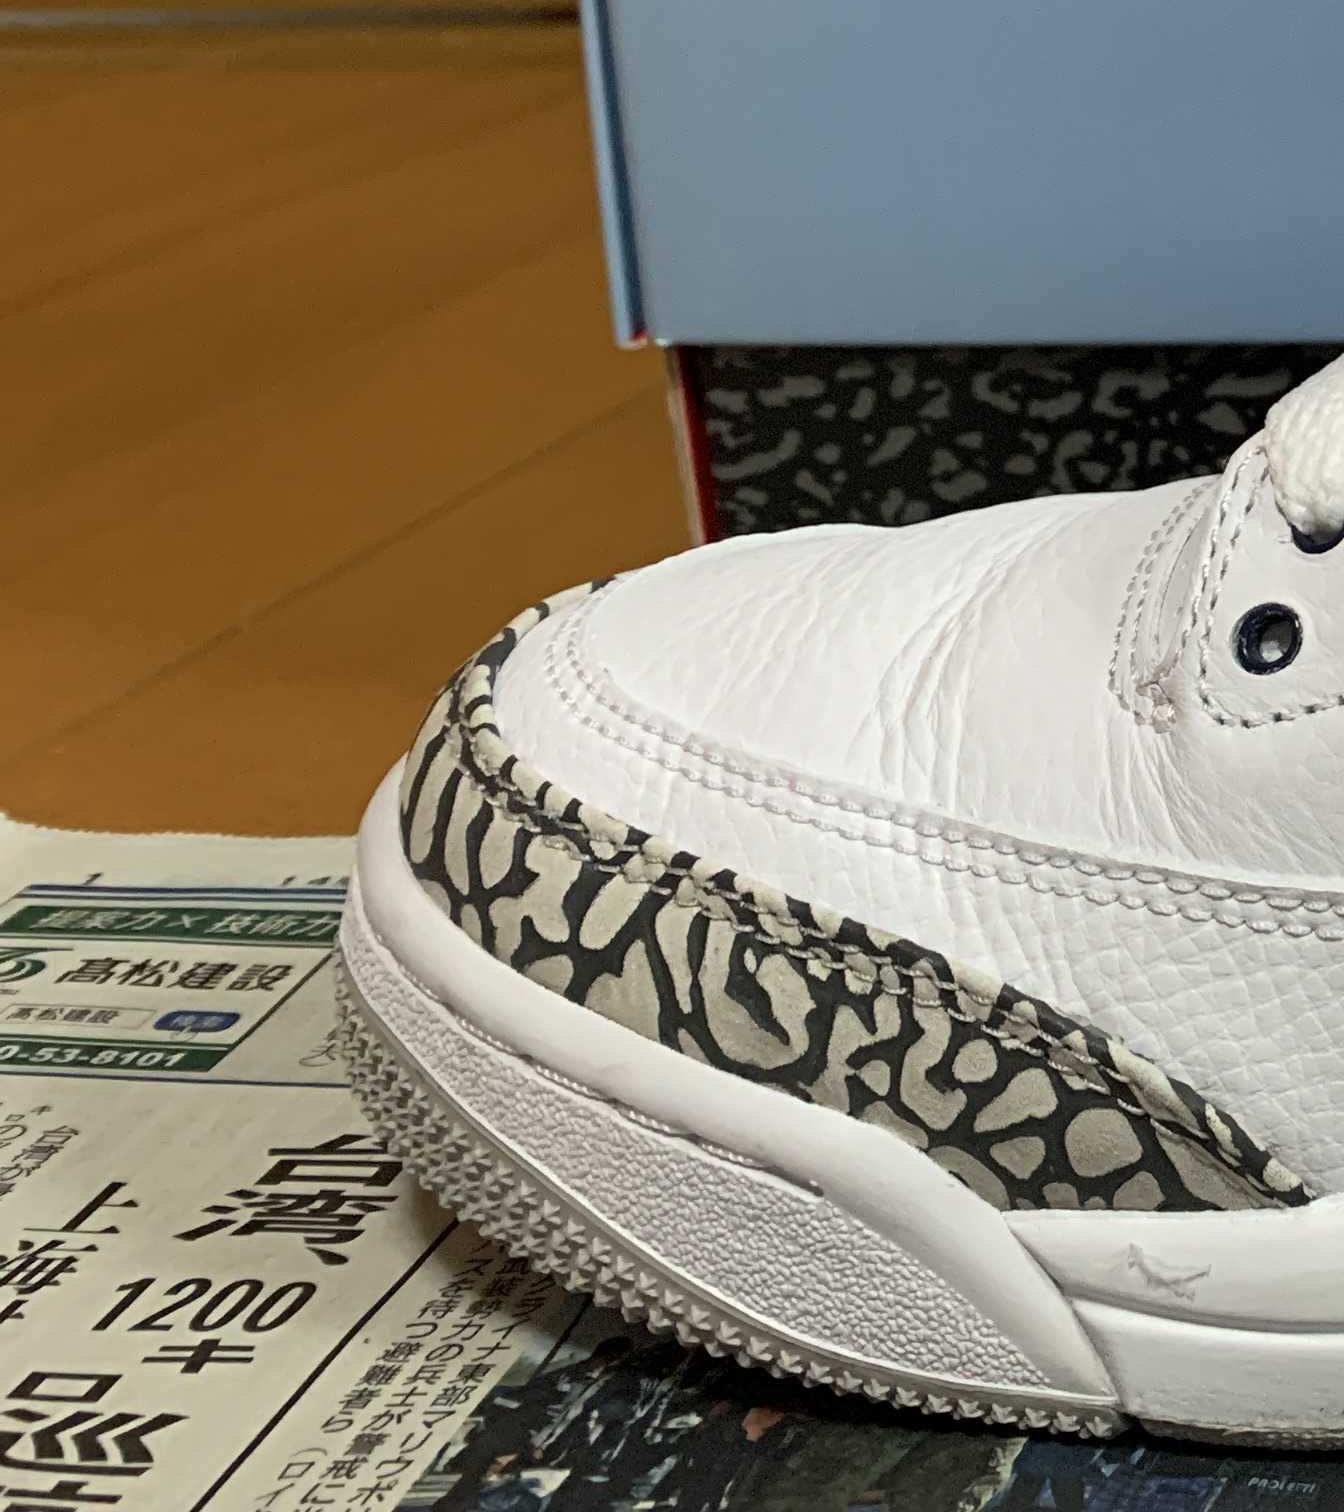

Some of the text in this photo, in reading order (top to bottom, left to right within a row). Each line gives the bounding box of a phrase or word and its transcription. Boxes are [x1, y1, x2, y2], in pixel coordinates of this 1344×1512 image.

[344, 1273, 557, 1512] クライナ東部マリウポ
